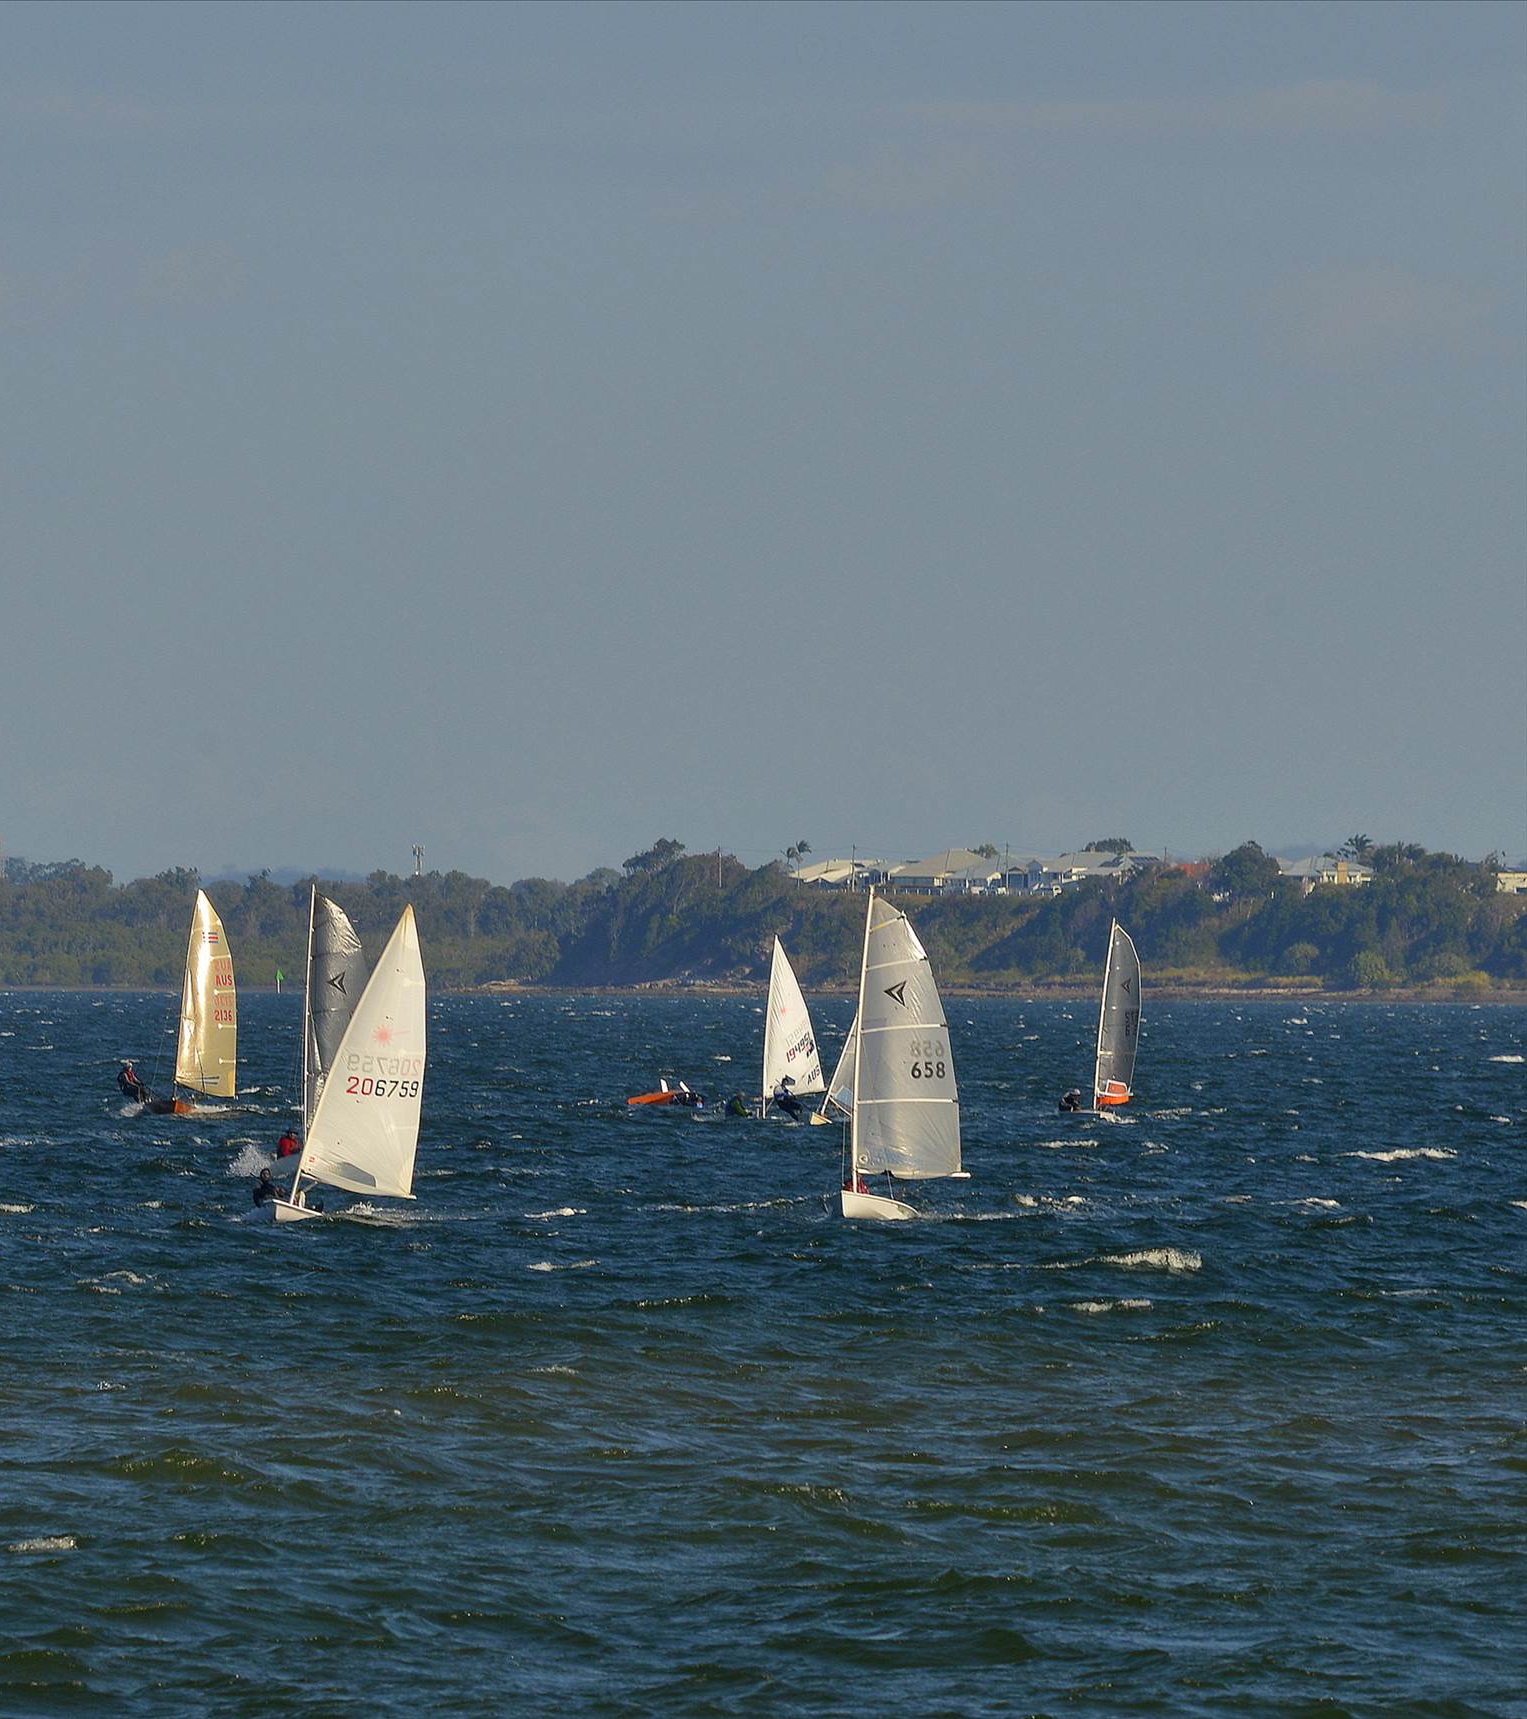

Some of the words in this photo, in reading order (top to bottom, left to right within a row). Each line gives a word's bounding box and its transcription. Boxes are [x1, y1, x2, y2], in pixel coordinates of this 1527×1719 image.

[215, 974, 234, 986] AUS
[807, 1064, 821, 1086] AUS
[911, 1060, 946, 1079] 658
[345, 1076, 420, 1098] 206759
